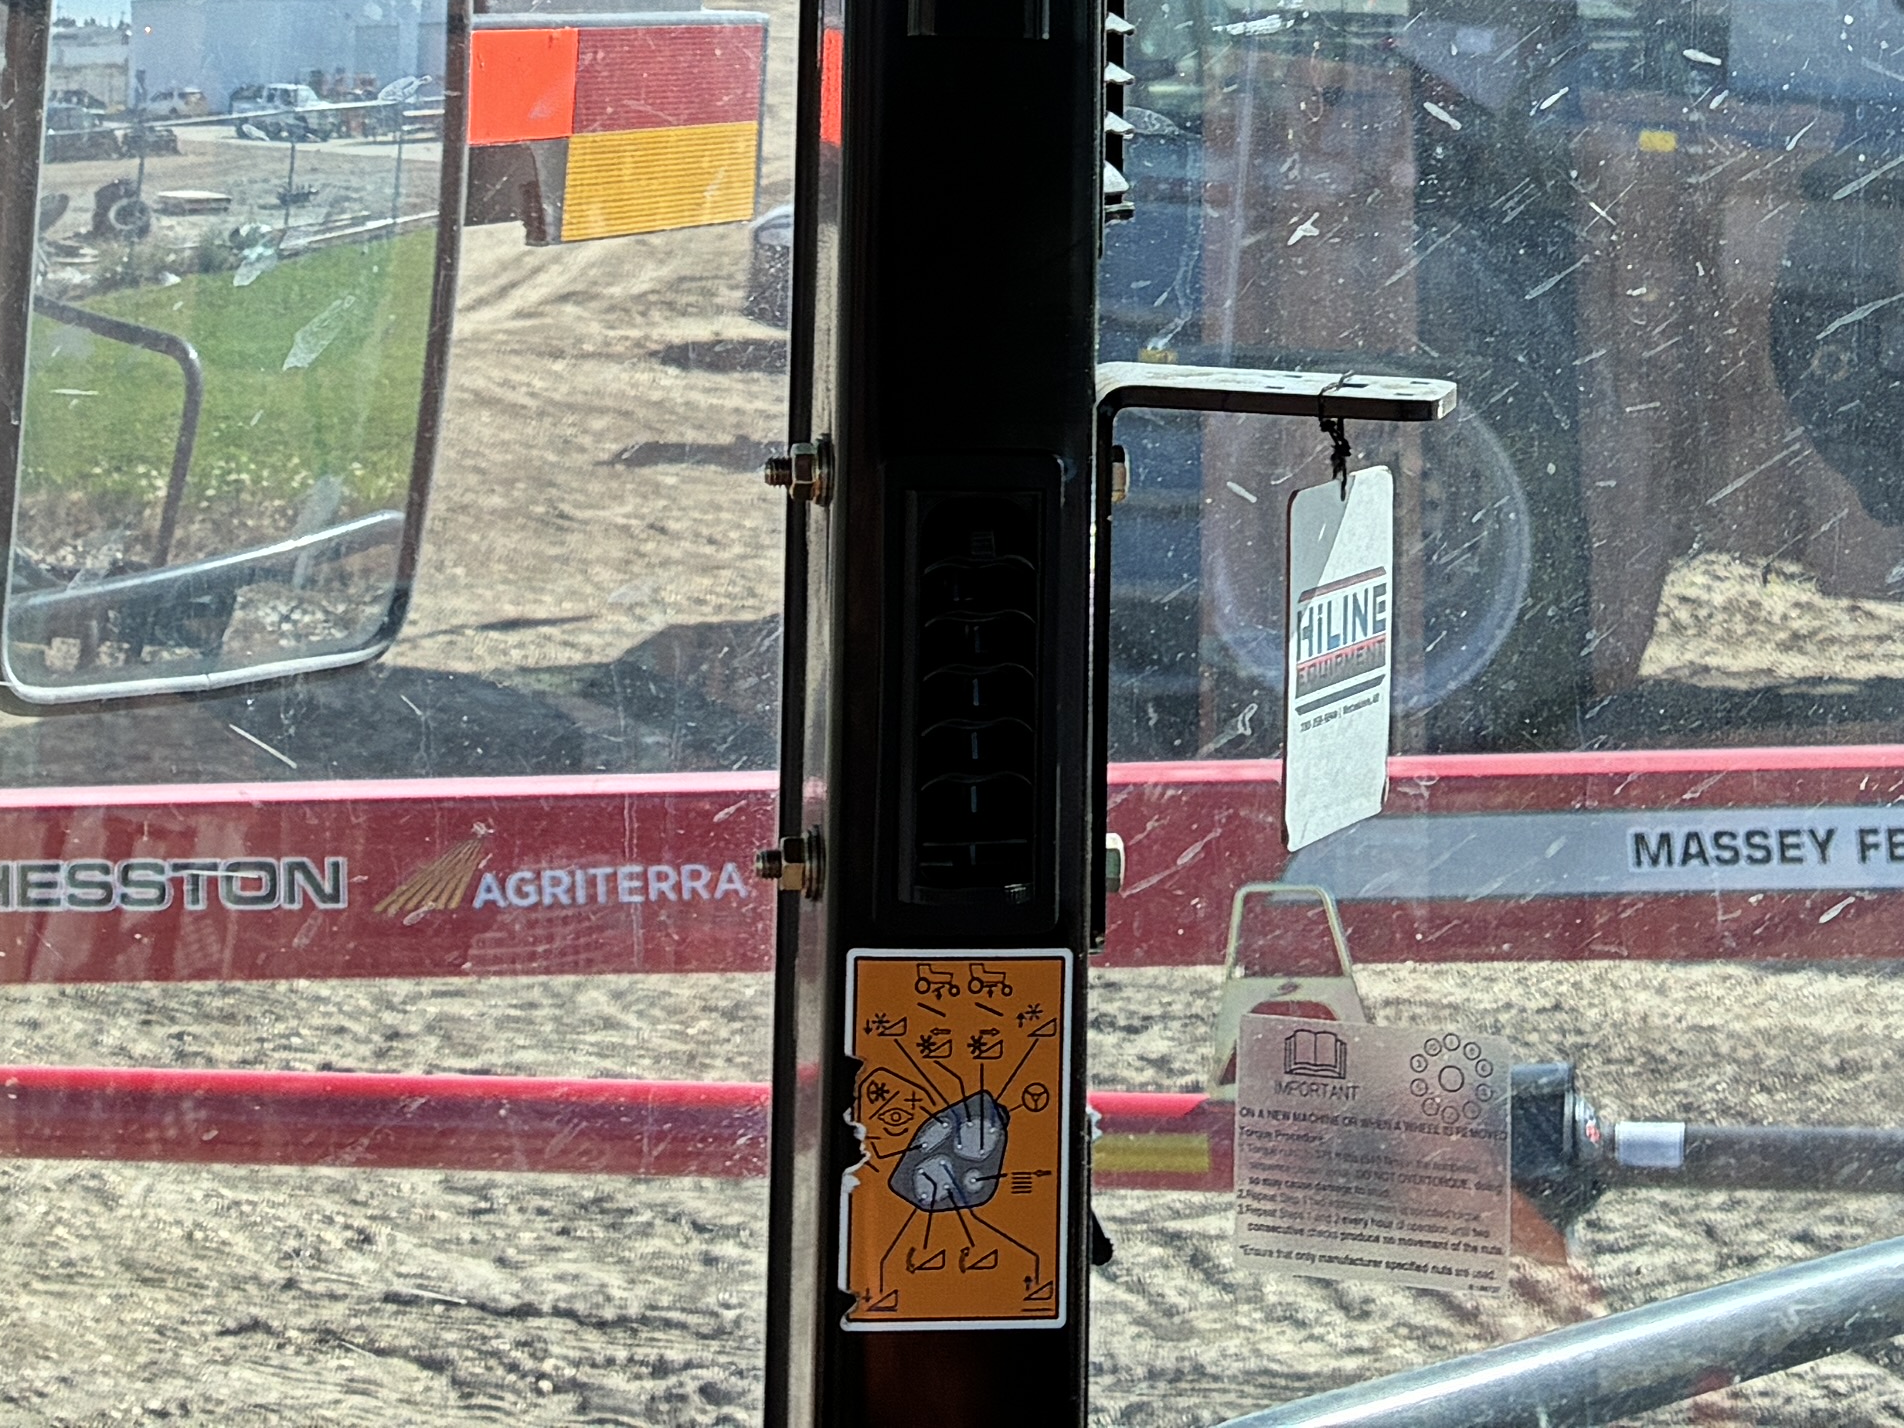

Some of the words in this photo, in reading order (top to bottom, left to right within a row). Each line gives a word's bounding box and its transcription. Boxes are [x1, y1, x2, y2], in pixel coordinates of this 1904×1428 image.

[1298, 637, 1386, 688] EQUIPMENT
[1632, 828, 1836, 868] MASSEY
[472, 862, 750, 909] AGRITERRA
[1274, 1080, 1360, 1101] IMPORTANT
[1239, 1106, 1255, 1118] ON
[1257, 1108, 1264, 1119] A
[1267, 1109, 1292, 1121] NEW
[1293, 1111, 1340, 1126] MACHINE
[1342, 1116, 1357, 1127] OR
[1403, 1120, 1441, 1135] WHEEL
[1455, 1126, 1507, 1141] REMOVED
[1295, 1252, 1316, 1266] only
[1318, 1254, 1383, 1268] manufacturer
[1398, 1237, 1449, 1250] movement
